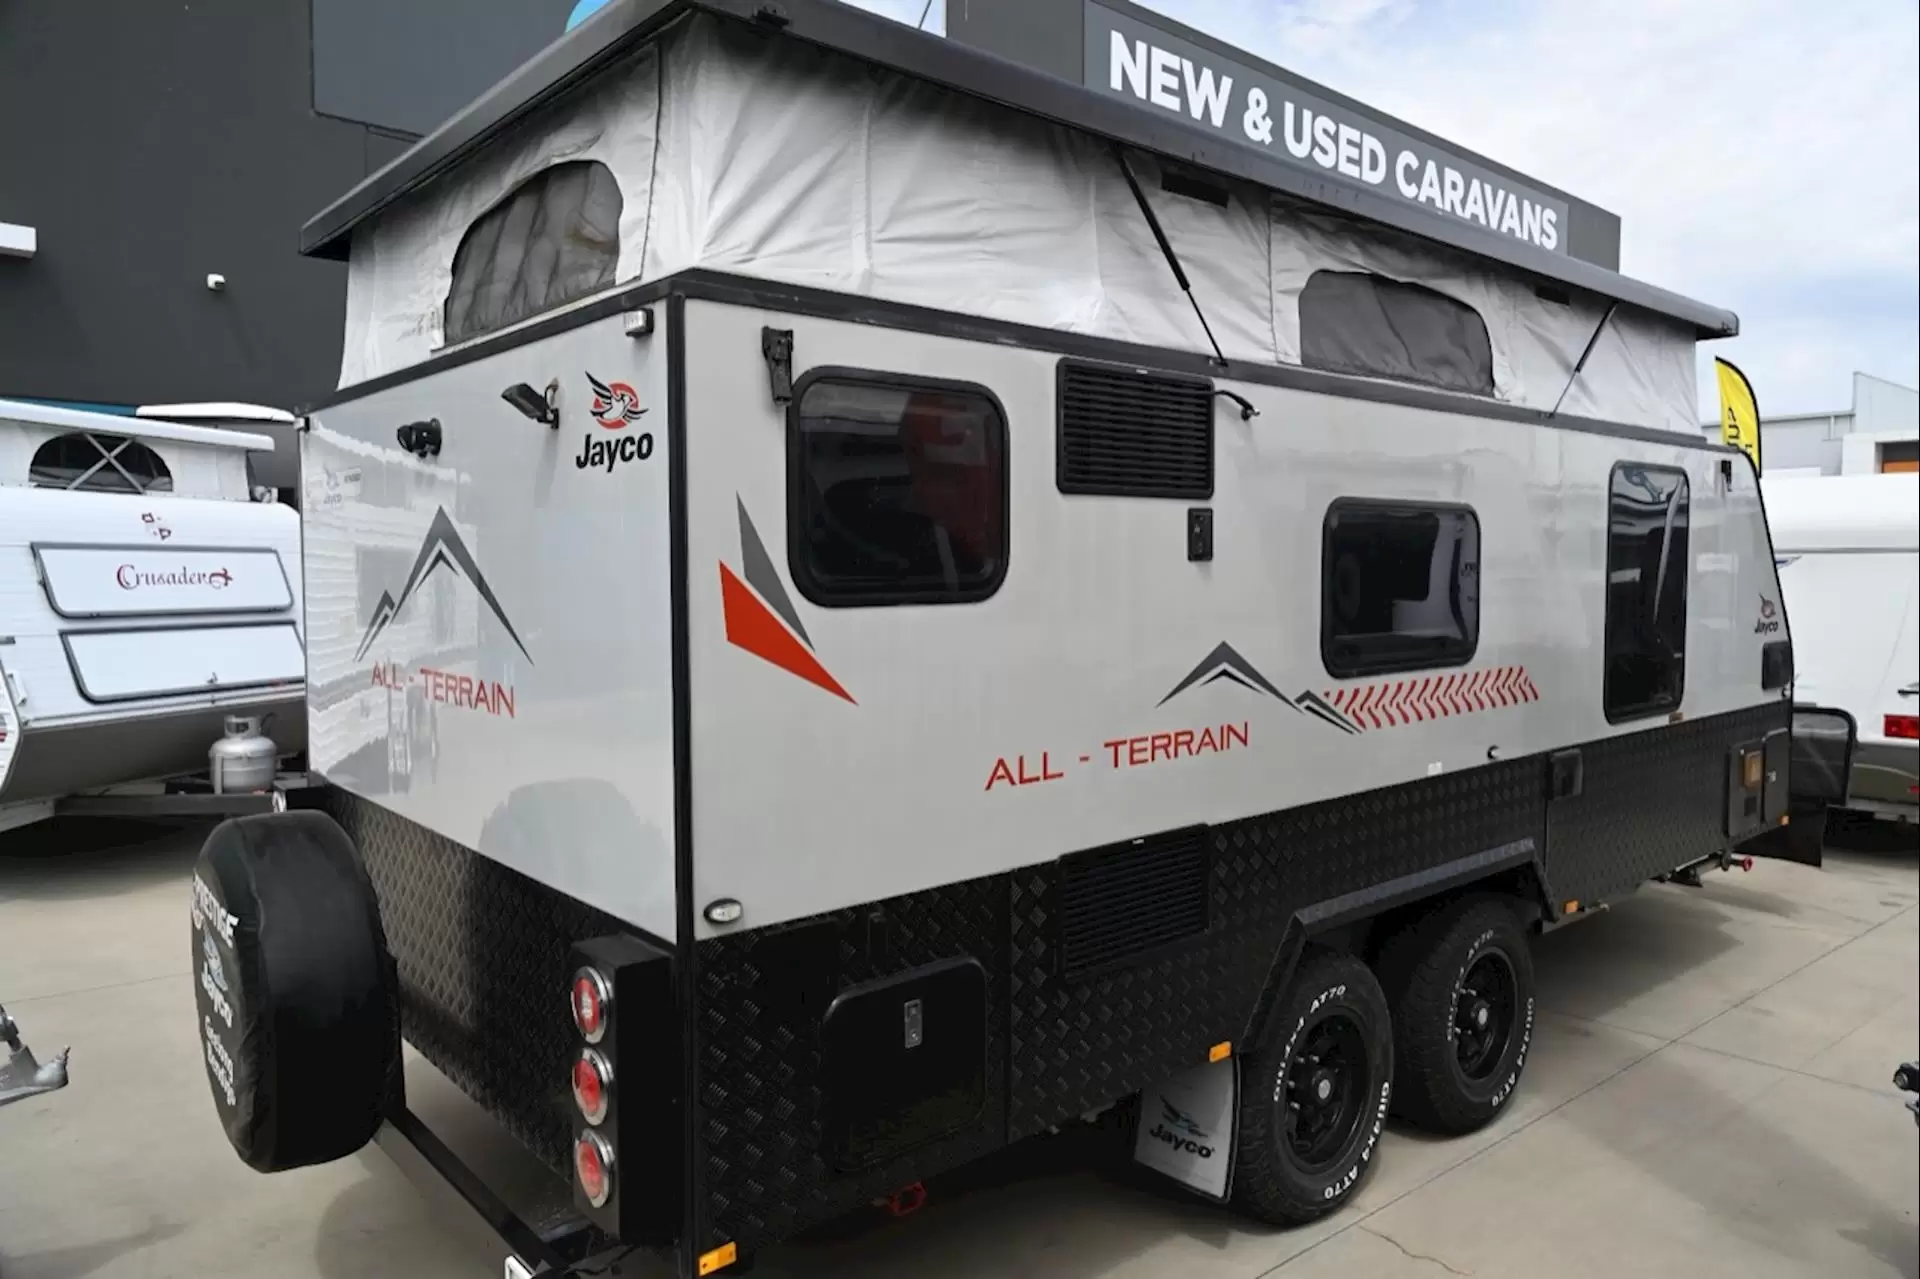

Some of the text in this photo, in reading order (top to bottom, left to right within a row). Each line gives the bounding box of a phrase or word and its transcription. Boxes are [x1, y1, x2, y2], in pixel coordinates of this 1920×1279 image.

[1110, 30, 1558, 250] NEW & USED CARAVANS
[576, 432, 654, 474] Jayco
[116, 563, 207, 590] Crusader
[1754, 617, 1779, 637] Jayco
[371, 660, 403, 691] ALL
[419, 667, 516, 719] TERRAIN
[984, 750, 1064, 791] ALL
[1103, 721, 1249, 769] TERRAIN
[202, 961, 233, 1029] Jayco
[1310, 984, 1347, 1014] AT70
[1149, 1123, 1213, 1159] Jayco
[1324, 1164, 1358, 1199] AT70
